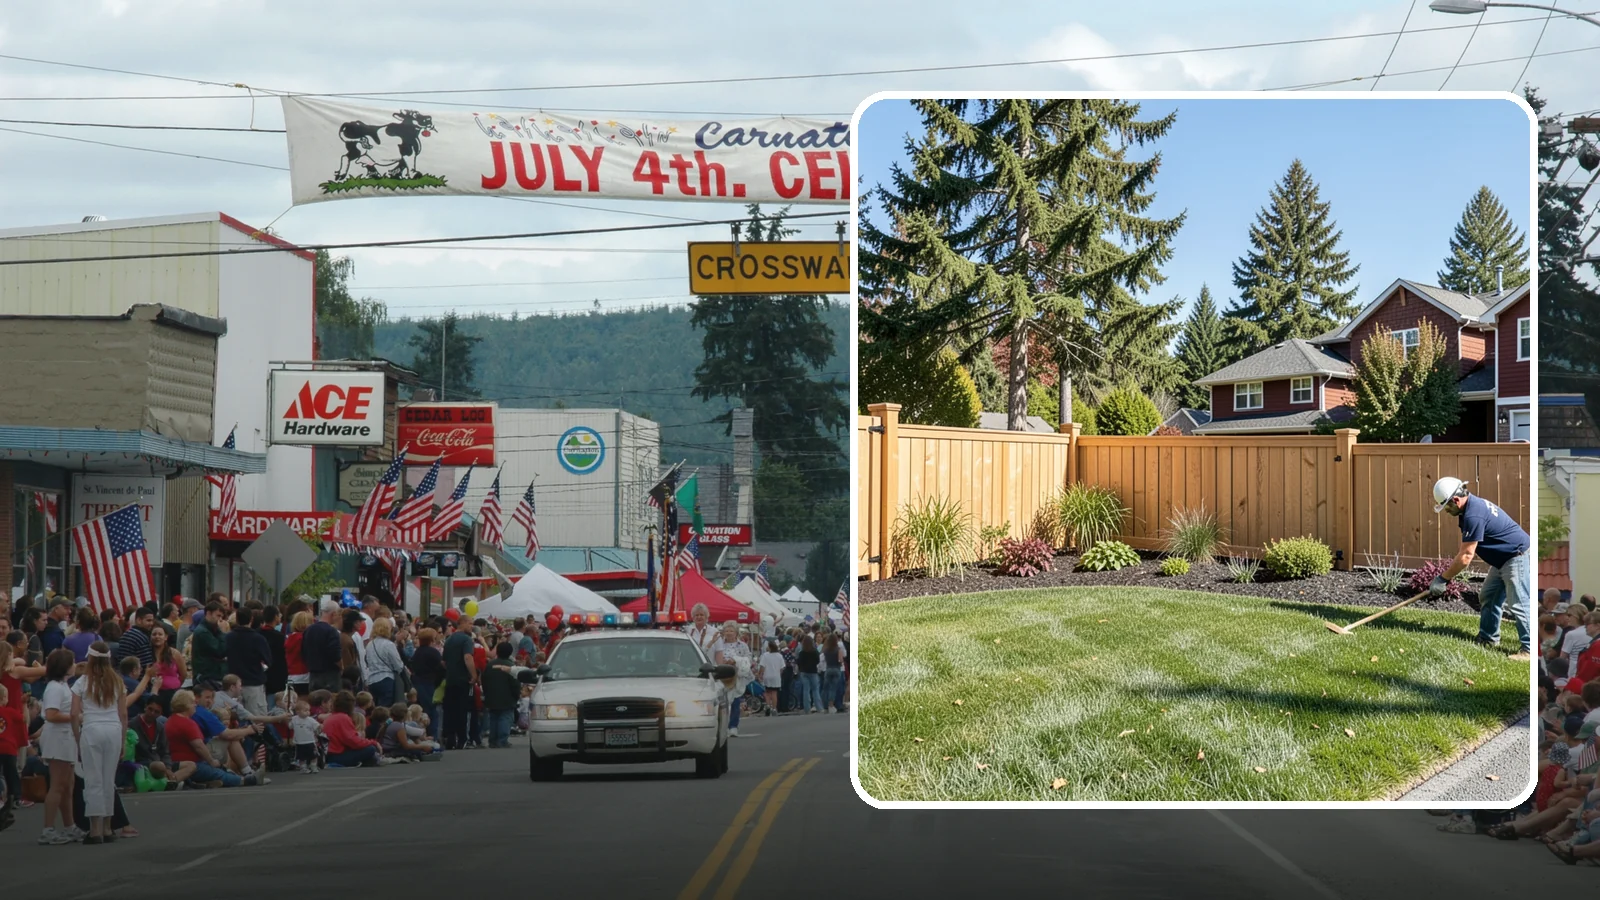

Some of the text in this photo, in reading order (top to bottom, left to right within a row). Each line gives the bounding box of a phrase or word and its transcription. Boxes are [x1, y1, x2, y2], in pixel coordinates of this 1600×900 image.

[480, 141, 604, 193] JULY
[632, 149, 747, 198] 4th.
[696, 253, 850, 281] CROSSWA
[282, 379, 374, 420] ACE
[405, 409, 452, 422] CEDAR
[283, 420, 371, 437] Hardware
[416, 427, 478, 447] Coca-Cola
[353, 467, 385, 482] Simpl
[95, 485, 124, 495] Vincent
[126, 486, 136, 495] de
[138, 486, 155, 495] Paul
[688, 526, 742, 535] CRNATION
[699, 535, 730, 544] GLASS
